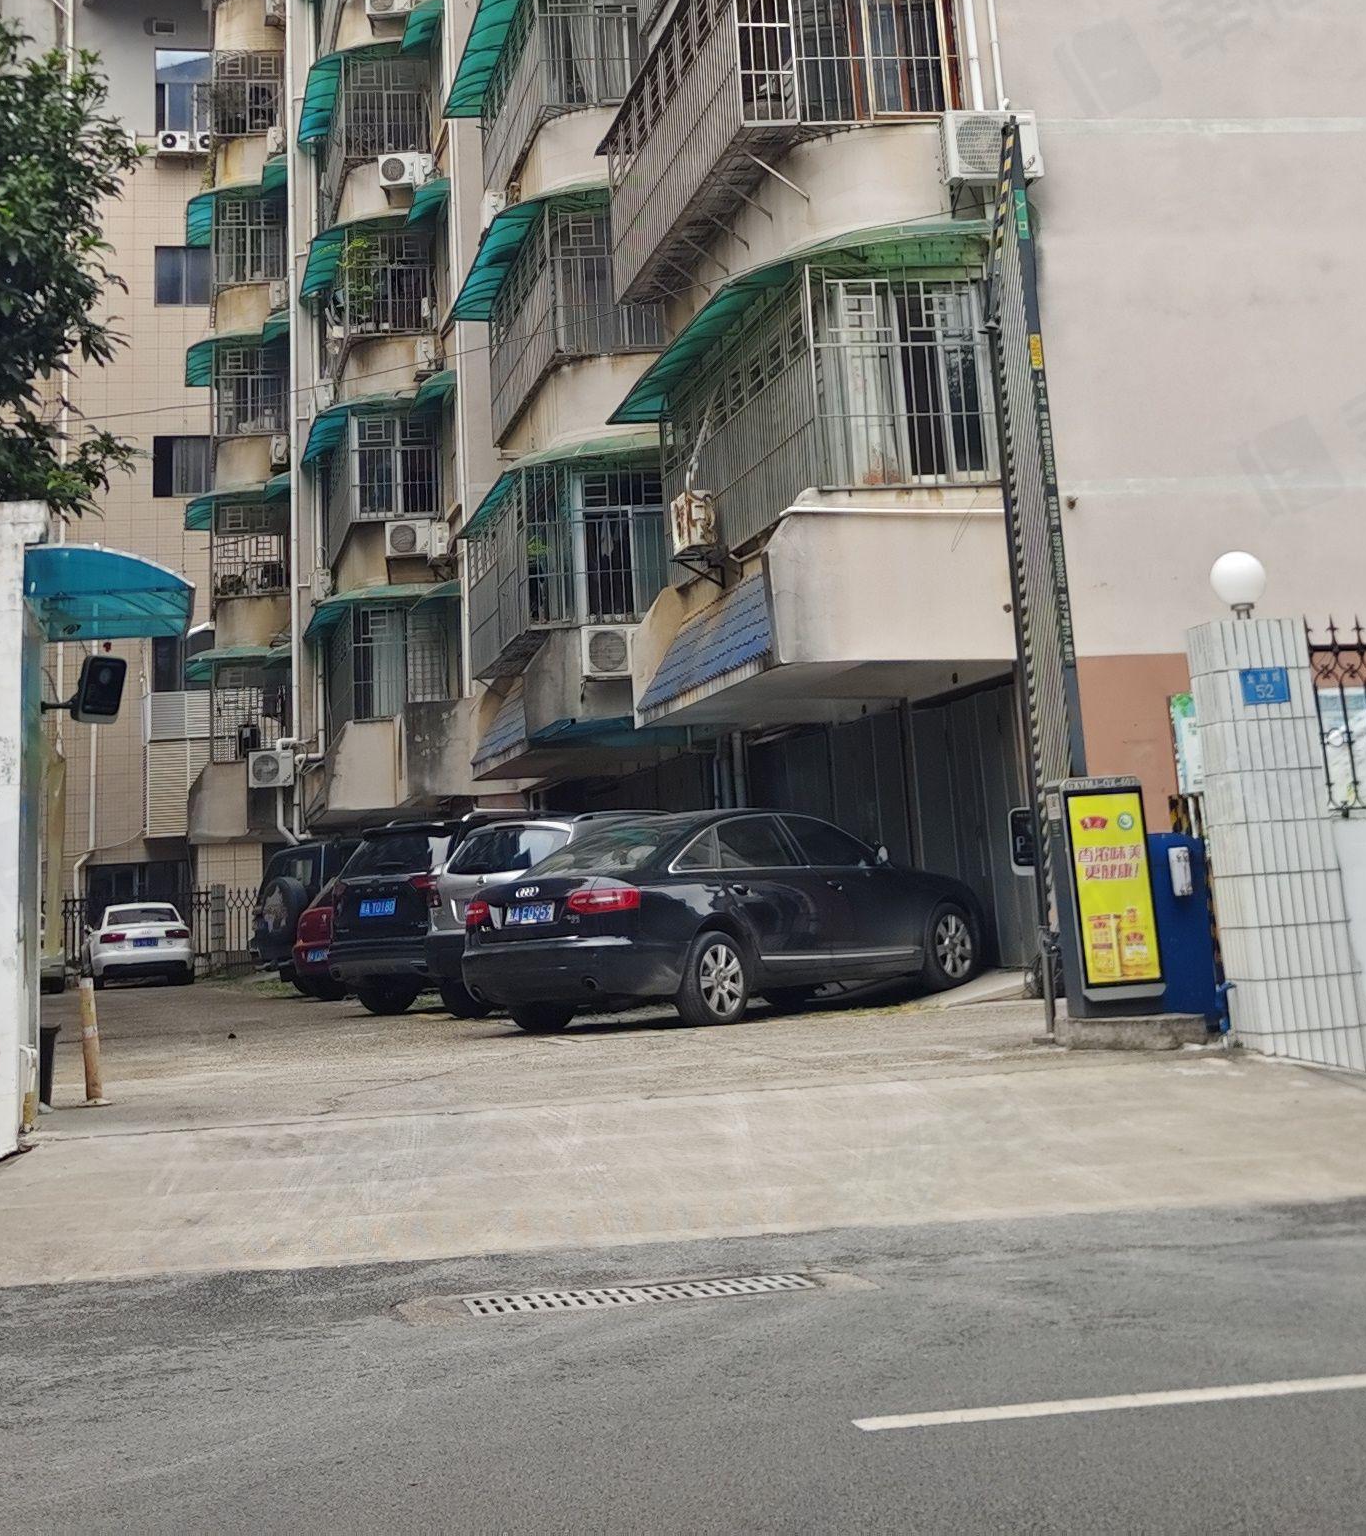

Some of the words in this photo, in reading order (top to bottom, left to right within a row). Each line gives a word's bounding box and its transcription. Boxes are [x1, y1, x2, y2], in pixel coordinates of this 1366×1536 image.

[1255, 683, 1275, 700] 52
[1015, 835, 1026, 854] P
[1077, 845, 1142, 863] 香浓味美
